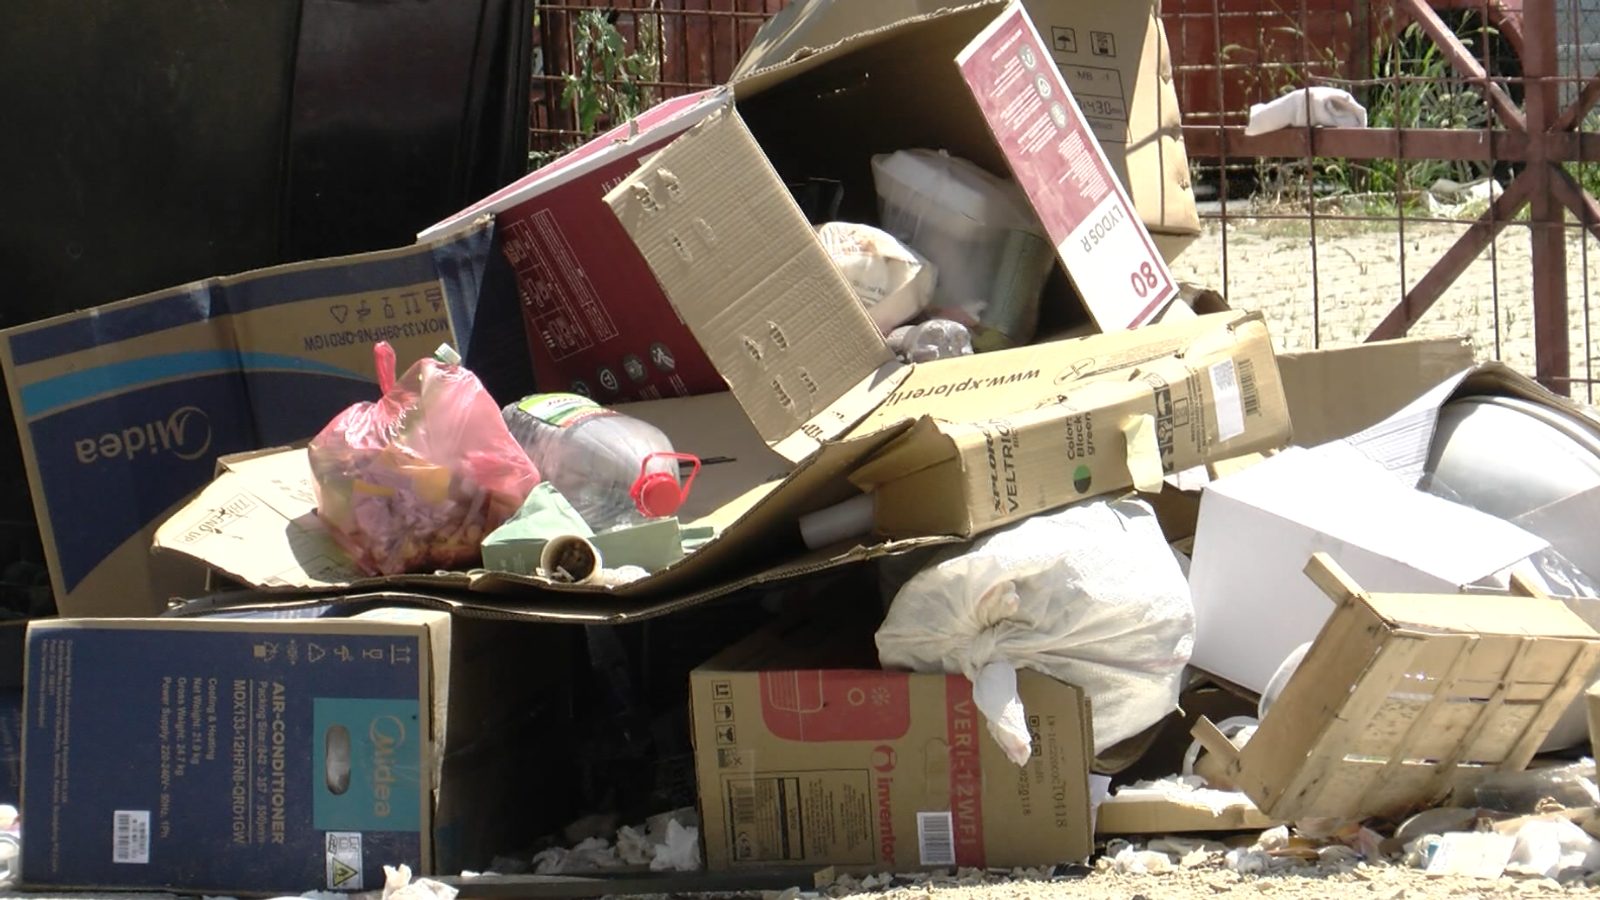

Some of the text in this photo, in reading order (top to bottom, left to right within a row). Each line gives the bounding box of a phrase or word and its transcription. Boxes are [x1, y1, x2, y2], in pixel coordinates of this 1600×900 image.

[1091, 204, 1123, 247] LYDOS
[1130, 261, 1158, 298] 80
[74, 406, 212, 463] Midea
[1074, 415, 1085, 459] Black
[1084, 411, 1096, 455] green
[161, 676, 172, 706] Power
[176, 677, 187, 705] Gross
[192, 677, 202, 694] Net
[206, 677, 217, 713] Cooling
[257, 681, 269, 719] Packing
[159, 707, 171, 741] Supply:
[174, 706, 186, 741] Weight:
[190, 695, 202, 728] Weight:
[190, 752, 201, 765] kg
[206, 724, 217, 761] Heating
[174, 764, 185, 776] kg
[271, 681, 286, 845] AIR-CONDITIONER
[369, 713, 405, 819] Midea
[952, 701, 977, 844] VERI-12WFI
[873, 777, 897, 865] inventor
